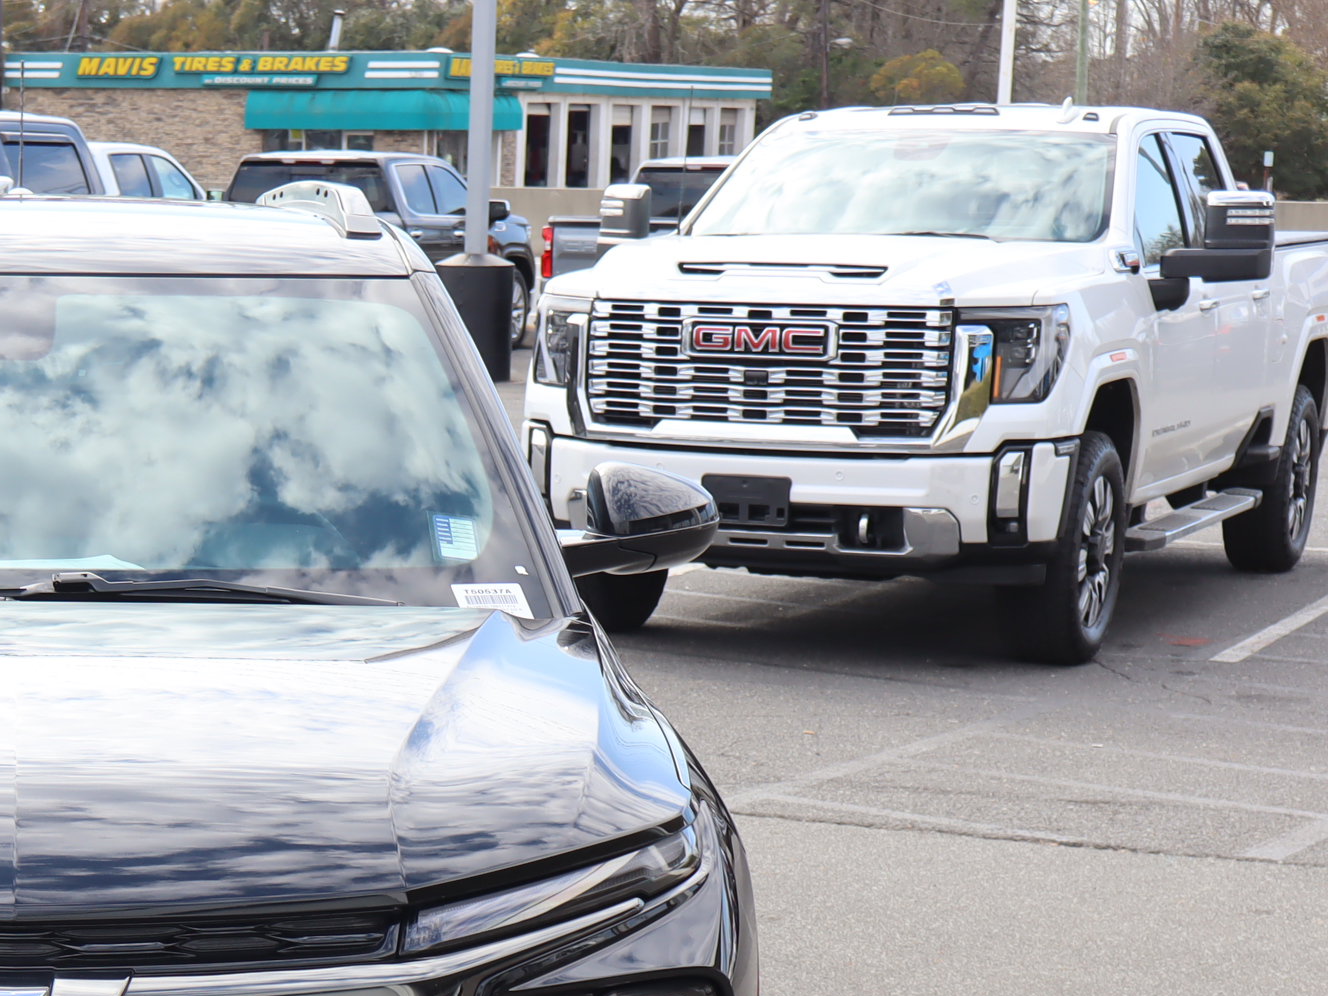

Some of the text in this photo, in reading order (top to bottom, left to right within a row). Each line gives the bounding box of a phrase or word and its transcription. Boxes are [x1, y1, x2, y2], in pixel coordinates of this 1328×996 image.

[77, 57, 158, 76] MAVIS
[173, 56, 350, 72] TIRES & BRAKES
[213, 77, 270, 85] DISCOUNT
[272, 77, 315, 85] PRICES
[693, 325, 824, 353] GMC
